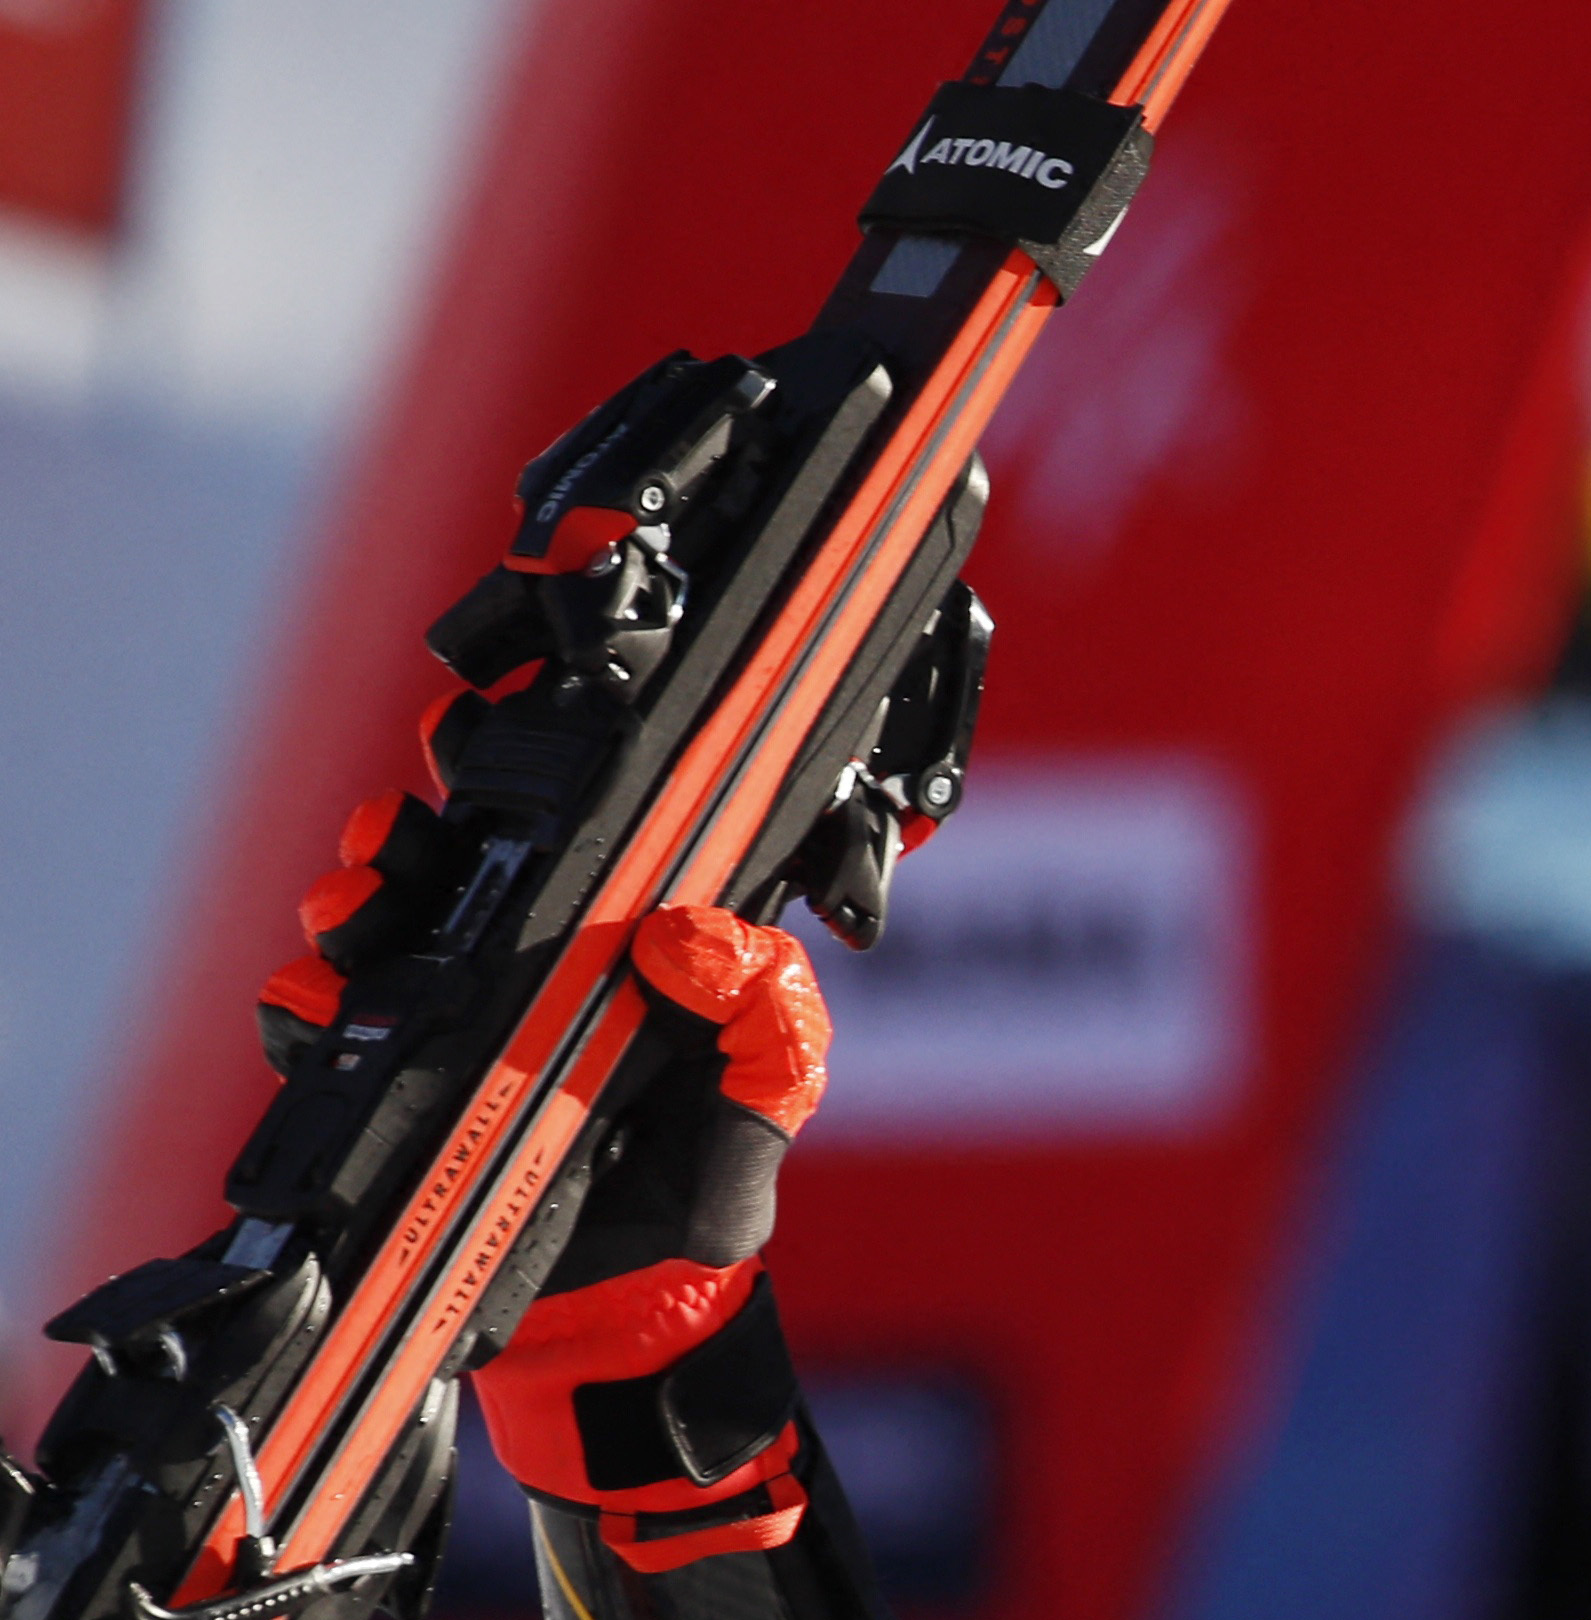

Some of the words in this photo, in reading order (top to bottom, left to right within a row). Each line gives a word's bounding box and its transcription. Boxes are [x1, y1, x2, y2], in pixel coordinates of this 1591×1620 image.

[920, 138, 1074, 189] ATOMIC
[404, 1098, 501, 1244] ULTRAWALL
[446, 1171, 540, 1315] ULTRAWALL
